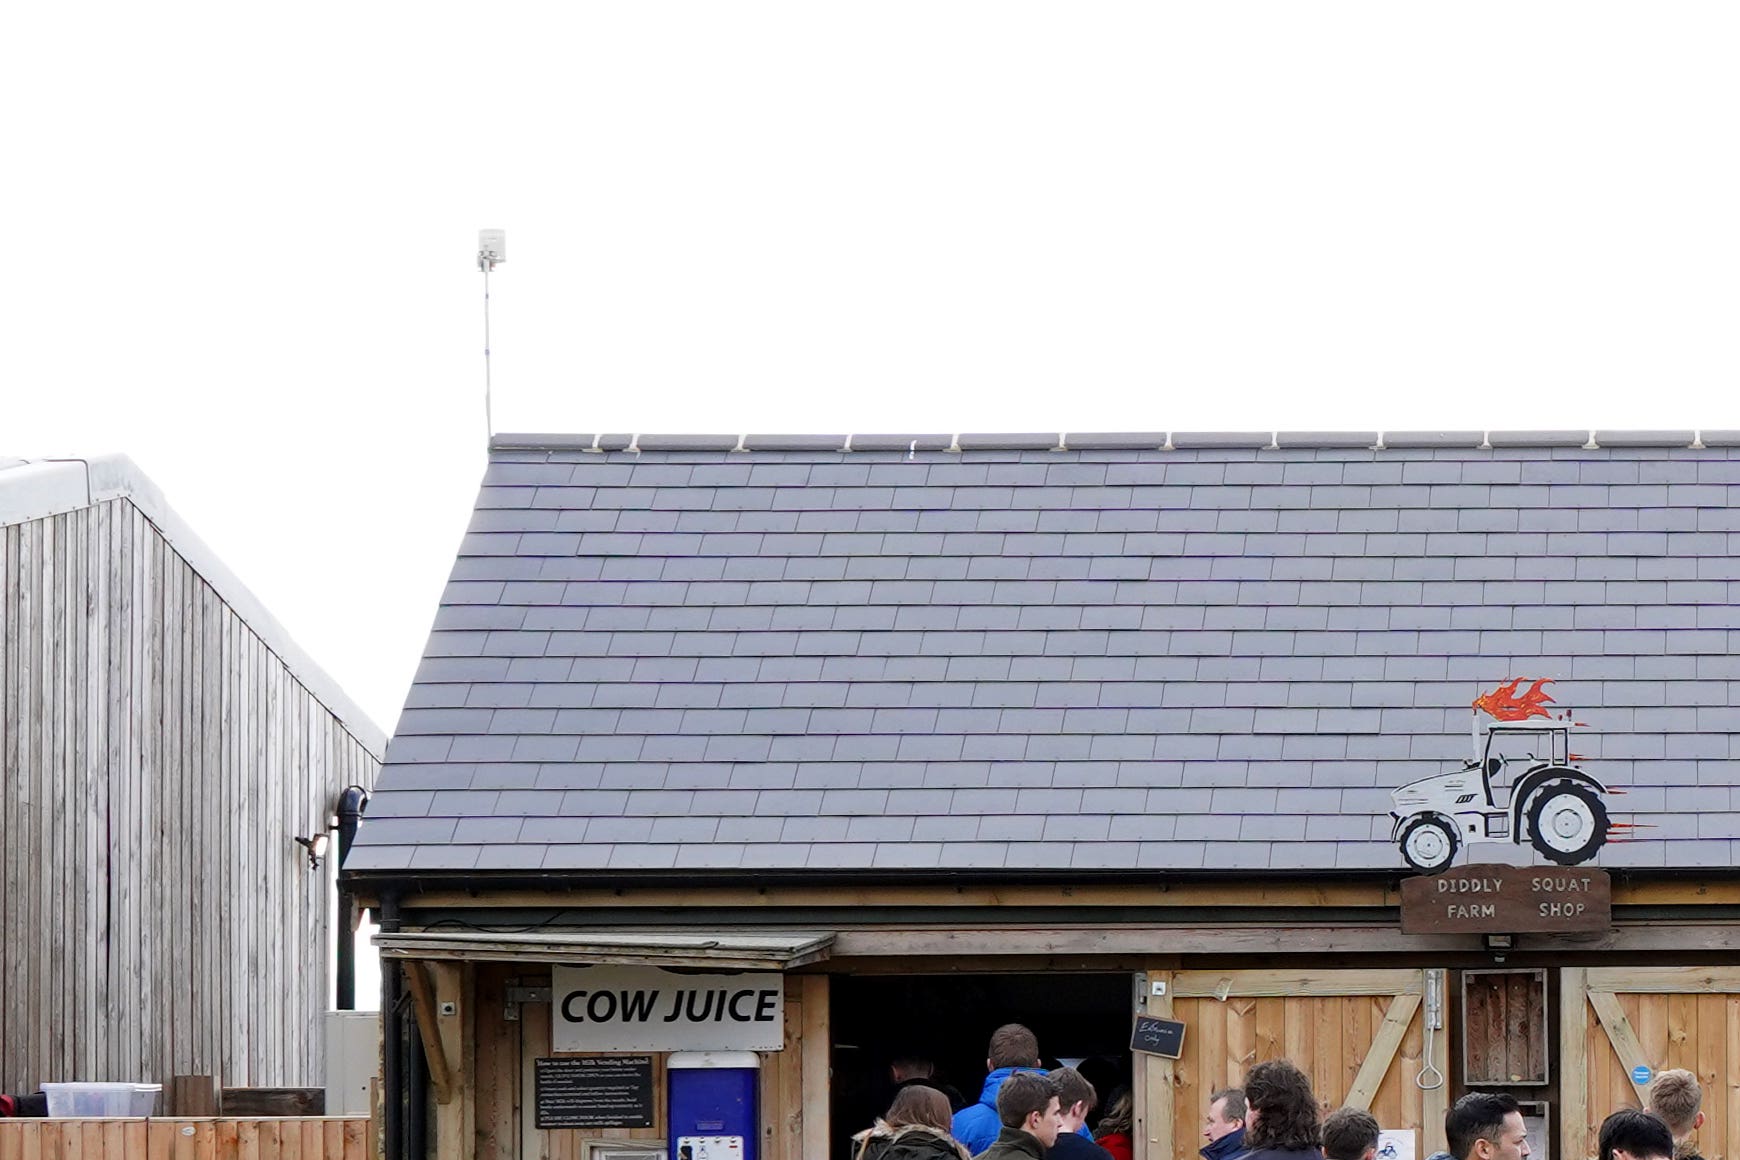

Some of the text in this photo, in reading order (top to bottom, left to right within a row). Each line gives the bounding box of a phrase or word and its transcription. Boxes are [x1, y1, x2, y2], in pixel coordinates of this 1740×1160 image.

[1437, 877, 1591, 893] DIDDLY SQUAT
[1447, 902, 1586, 919] FARM SHOP
[561, 989, 779, 1023] COW JUICE
